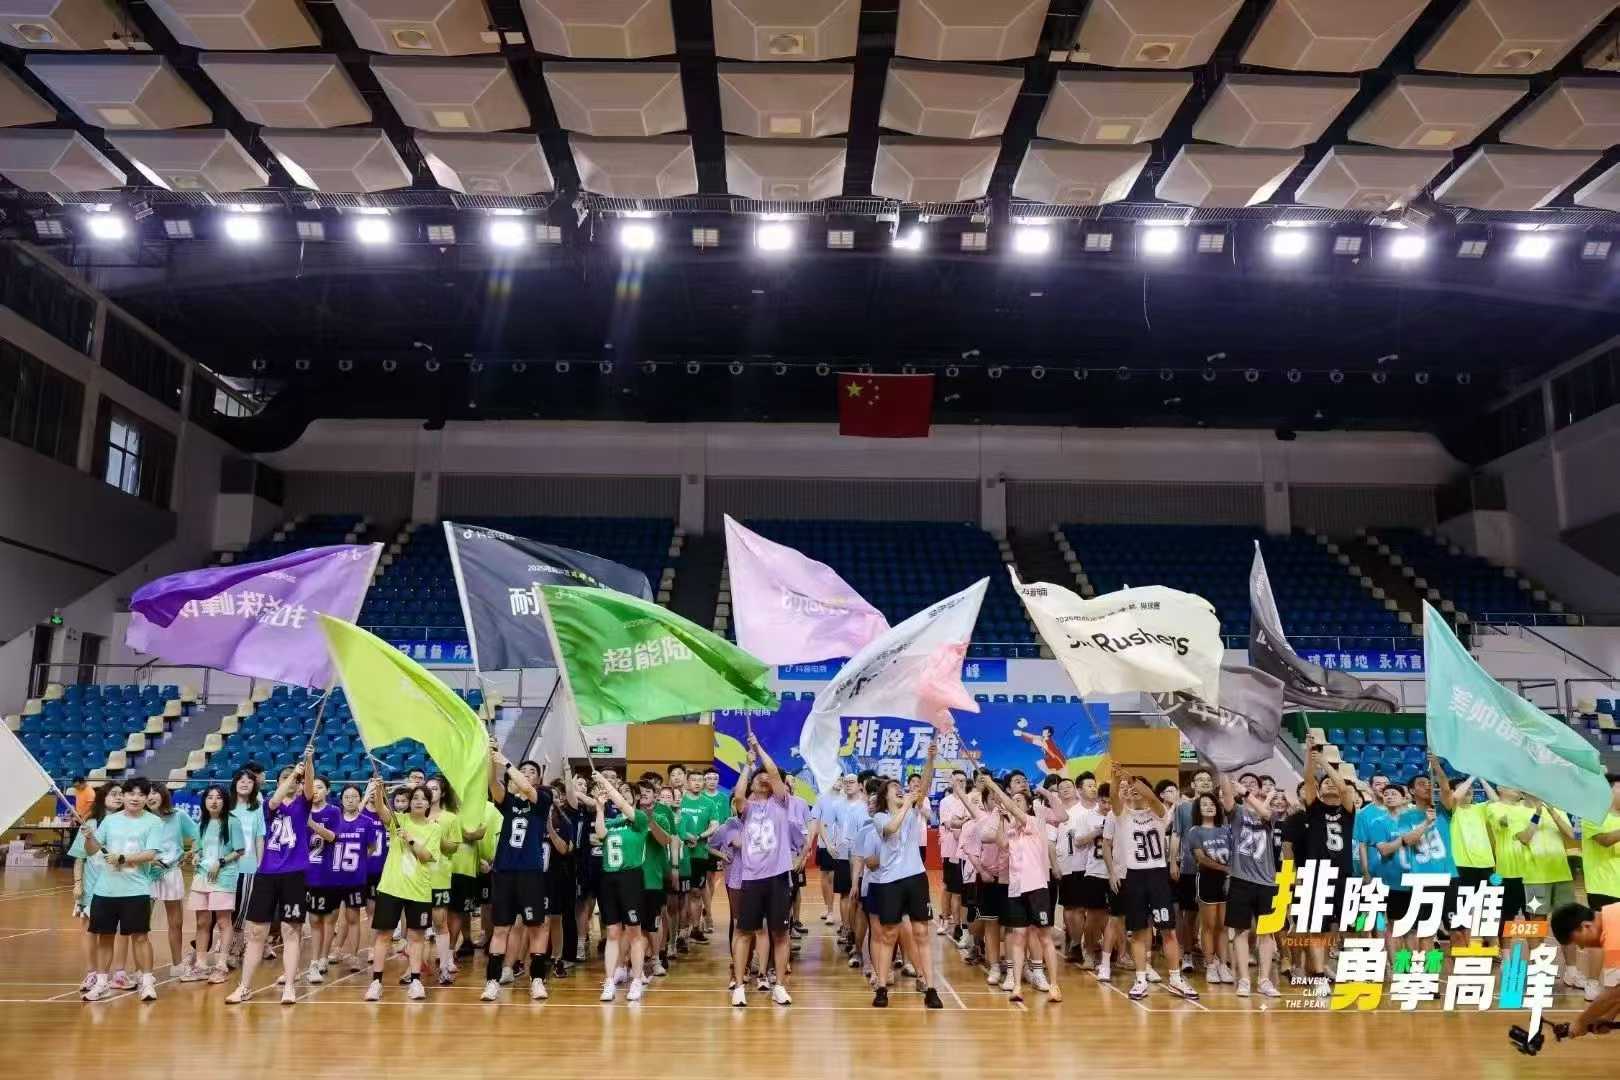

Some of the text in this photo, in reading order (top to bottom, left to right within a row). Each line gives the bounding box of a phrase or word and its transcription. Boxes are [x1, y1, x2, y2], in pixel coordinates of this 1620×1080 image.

[266, 815, 297, 852] 24
[509, 816, 529, 849] 6
[1133, 829, 1162, 862] 30
[332, 842, 361, 872] 15
[284, 903, 302, 918] 24
[1152, 907, 1169, 923] 30
